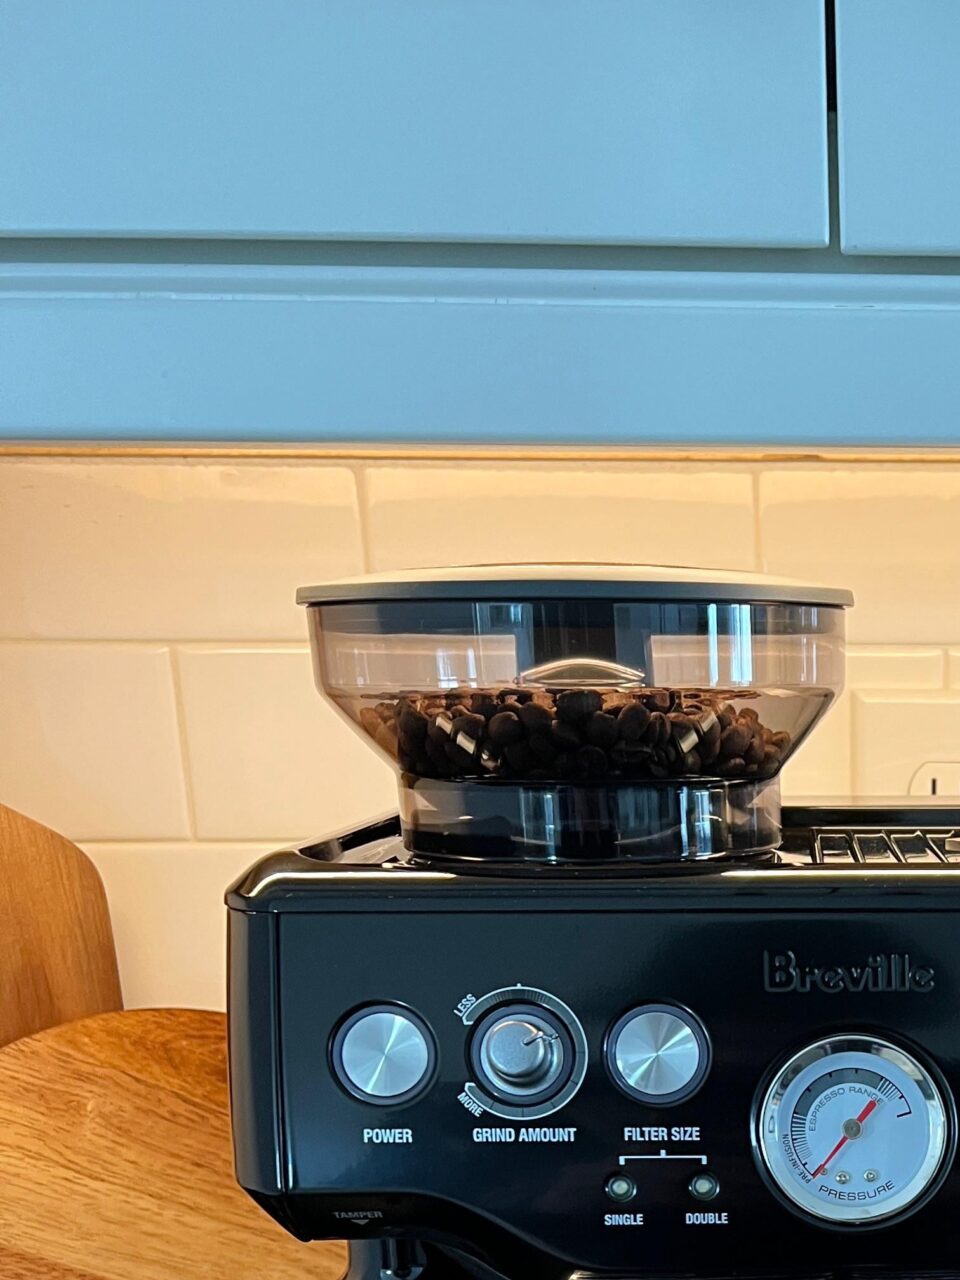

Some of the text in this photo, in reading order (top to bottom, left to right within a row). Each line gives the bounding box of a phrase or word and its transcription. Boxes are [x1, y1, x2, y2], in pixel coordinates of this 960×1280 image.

[763, 950, 937, 994] Breville
[453, 993, 477, 1017] LESS
[456, 1091, 484, 1117] MORE
[808, 1085, 886, 1132] ESPRESSO RANGE
[363, 1128, 413, 1143] POWER
[472, 1127, 577, 1143] GRIND AMOUNT
[623, 1127, 701, 1141] FILTER SIZE
[781, 1133, 812, 1184] PRE-INFUSION
[818, 1180, 895, 1201] PRESSURE
[331, 1210, 384, 1219] TAMPER
[604, 1213, 644, 1225] SINGLE
[685, 1212, 728, 1224] DOUBLE
